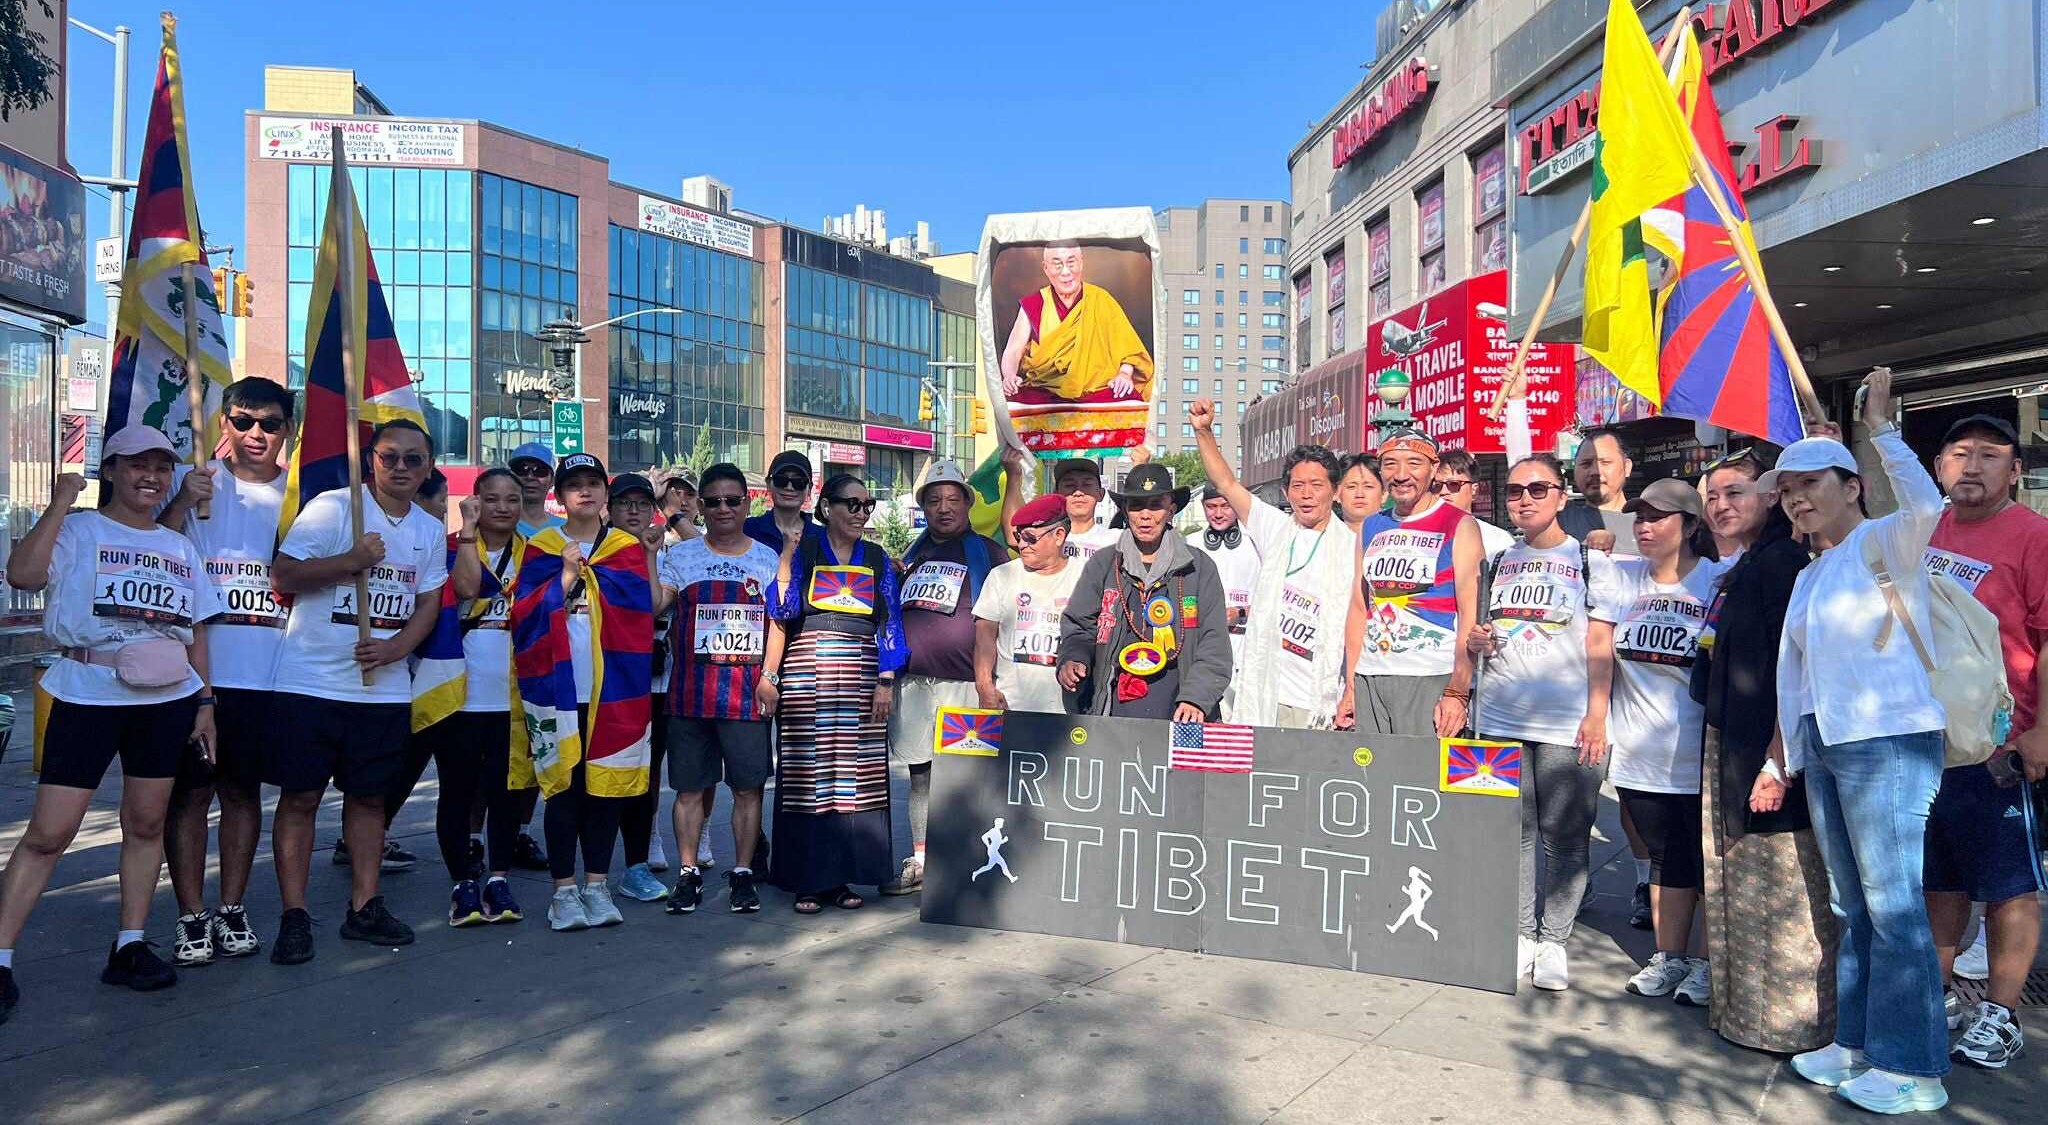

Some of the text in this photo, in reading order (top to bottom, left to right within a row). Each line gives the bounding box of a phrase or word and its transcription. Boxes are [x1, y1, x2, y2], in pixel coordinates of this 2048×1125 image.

[388, 124, 459, 134] INCOME TAX
[268, 149, 393, 162] 718-47-1111
[396, 148, 454, 157] ACCOUNTING
[669, 205, 709, 223] INSURANCE
[103, 245, 114, 257] NO
[7, 261, 33, 284] TASTE
[35, 272, 42, 286] &
[44, 274, 70, 294] FRESH
[96, 262, 120, 276] TURNS
[1415, 340, 1465, 380] TRAVEL
[506, 369, 552, 394] Wend
[1415, 373, 1465, 412] MOBILE
[619, 393, 666, 419] Wendy's
[1310, 407, 1345, 437] Discount
[1425, 406, 1465, 436] Travel
[1254, 429, 1281, 466] KABAB
[1064, 546, 1080, 557] FOR
[1389, 535, 1407, 546] FOR
[1411, 536, 1443, 549] TIBET
[99, 550, 192, 579] RUN FOR TIBET
[206, 561, 233, 575] RUN
[237, 562, 262, 577] FOR
[919, 565, 966, 578] FOR TIBET
[1374, 557, 1417, 580] 0006
[1498, 563, 1518, 577] RUN
[1520, 561, 1542, 573] FOR
[1546, 561, 1579, 579] TIBET
[1927, 555, 1986, 583] FOR TIBET
[369, 565, 417, 585] FOR TIBET
[122, 579, 175, 610] 0012
[227, 588, 276, 613] 0015
[908, 582, 947, 600] 0018
[1511, 584, 1555, 606] 0001
[1290, 594, 1312, 611] FOR
[1502, 608, 1520, 616] End
[1649, 599, 1669, 612] FOR
[1673, 601, 1708, 619] TIBET
[697, 609, 764, 622] RUN FOR TIBET
[1017, 609, 1060, 623] RUN FOR
[712, 632, 752, 652] 0021
[1031, 632, 1062, 655] 001
[1637, 624, 1688, 652] 0002
[1008, 750, 1441, 851] RUN FOR
[1044, 821, 1370, 934] TIBET
